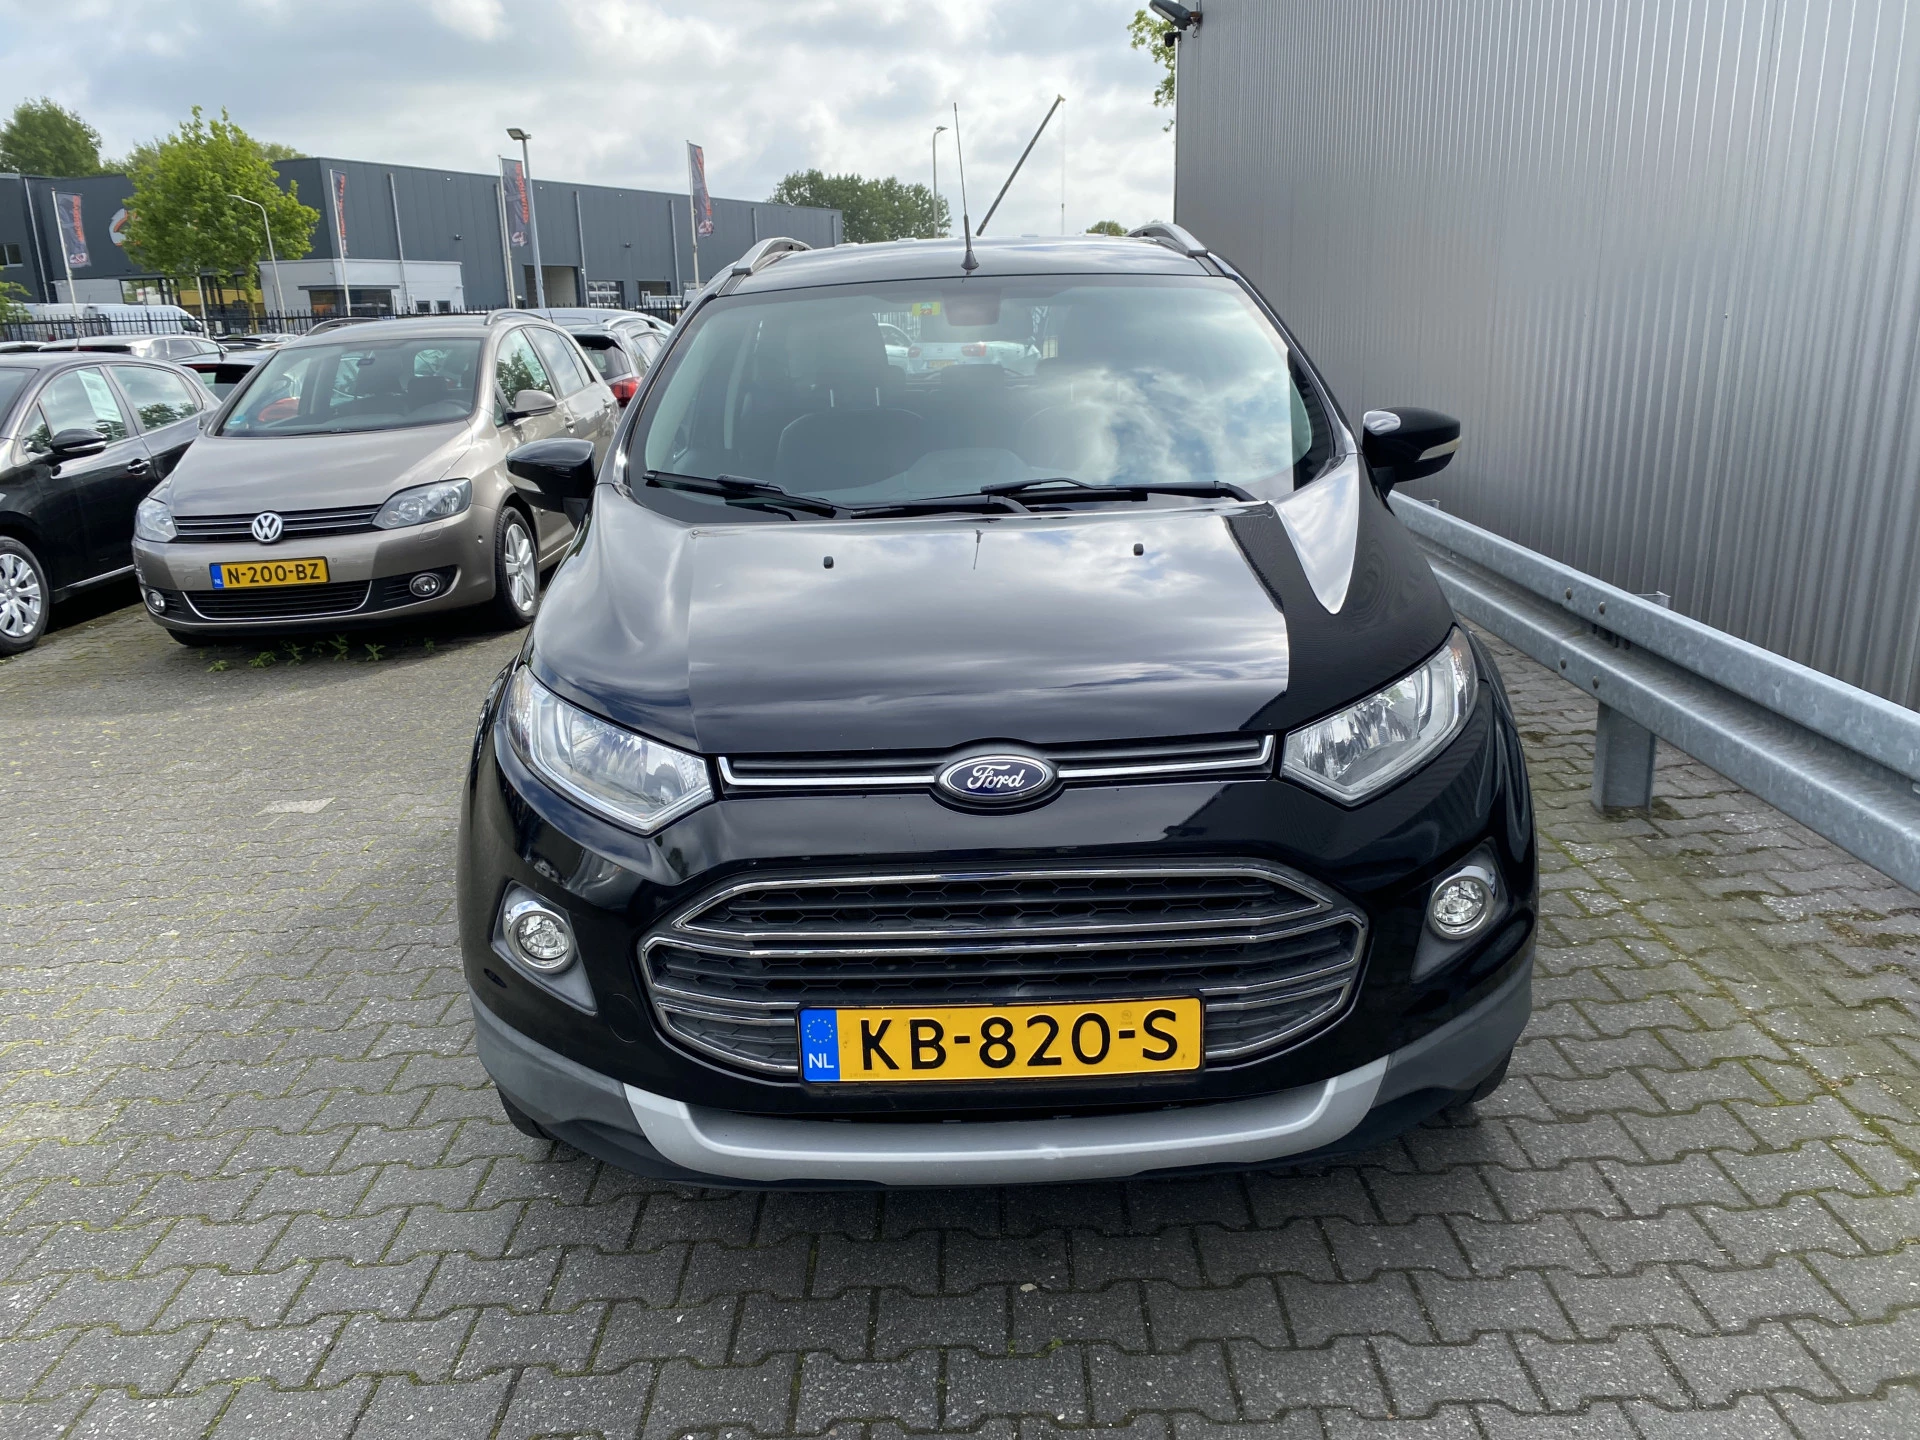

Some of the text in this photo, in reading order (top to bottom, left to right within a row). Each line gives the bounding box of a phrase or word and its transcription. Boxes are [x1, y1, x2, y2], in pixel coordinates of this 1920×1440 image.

[226, 562, 321, 585] N-200-BZ
[966, 764, 1026, 790] Ford
[860, 1008, 1179, 1071] KB-820-S
[808, 1053, 835, 1069] NL
